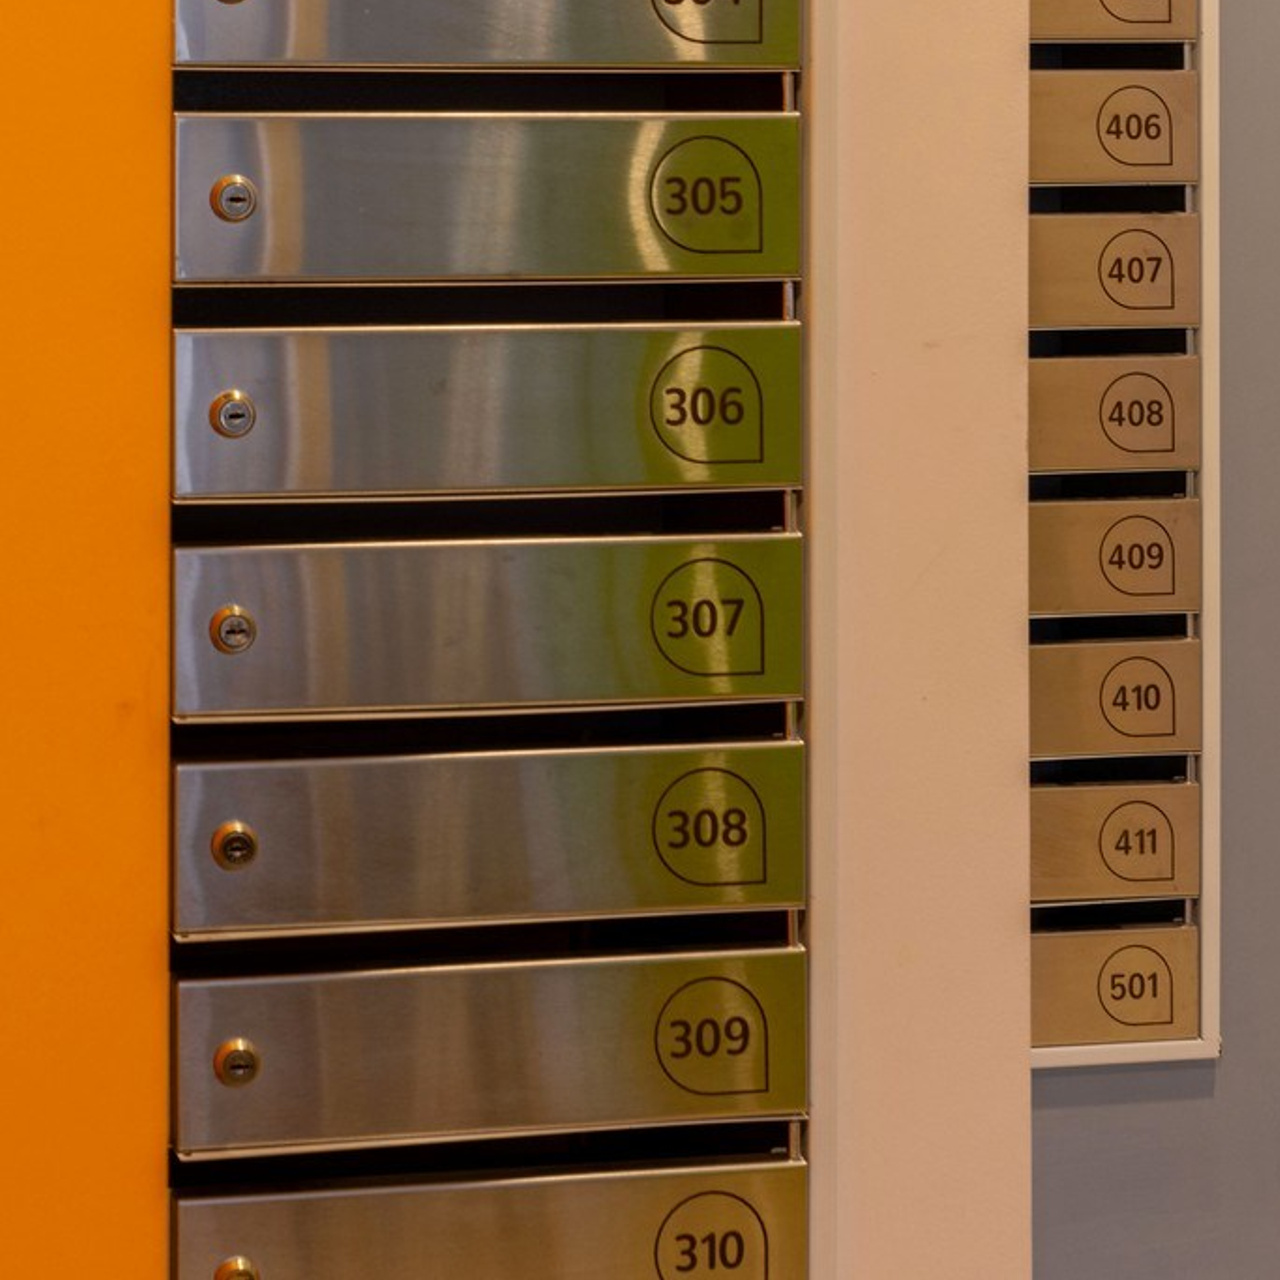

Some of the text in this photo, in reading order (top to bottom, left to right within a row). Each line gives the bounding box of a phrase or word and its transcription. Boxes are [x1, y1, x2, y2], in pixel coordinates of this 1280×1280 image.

[1106, 114, 1161, 140] 406
[666, 177, 742, 215] 305
[1108, 257, 1162, 283] 407
[666, 387, 743, 426] 306
[1109, 400, 1163, 426] 408
[1109, 543, 1163, 570] 409
[668, 599, 744, 638] 307
[1112, 684, 1160, 711] 410
[669, 808, 747, 848] 308
[1115, 829, 1156, 855] 411
[1111, 972, 1157, 1000] 501
[671, 1016, 750, 1058] 309
[676, 1231, 744, 1272] 310
